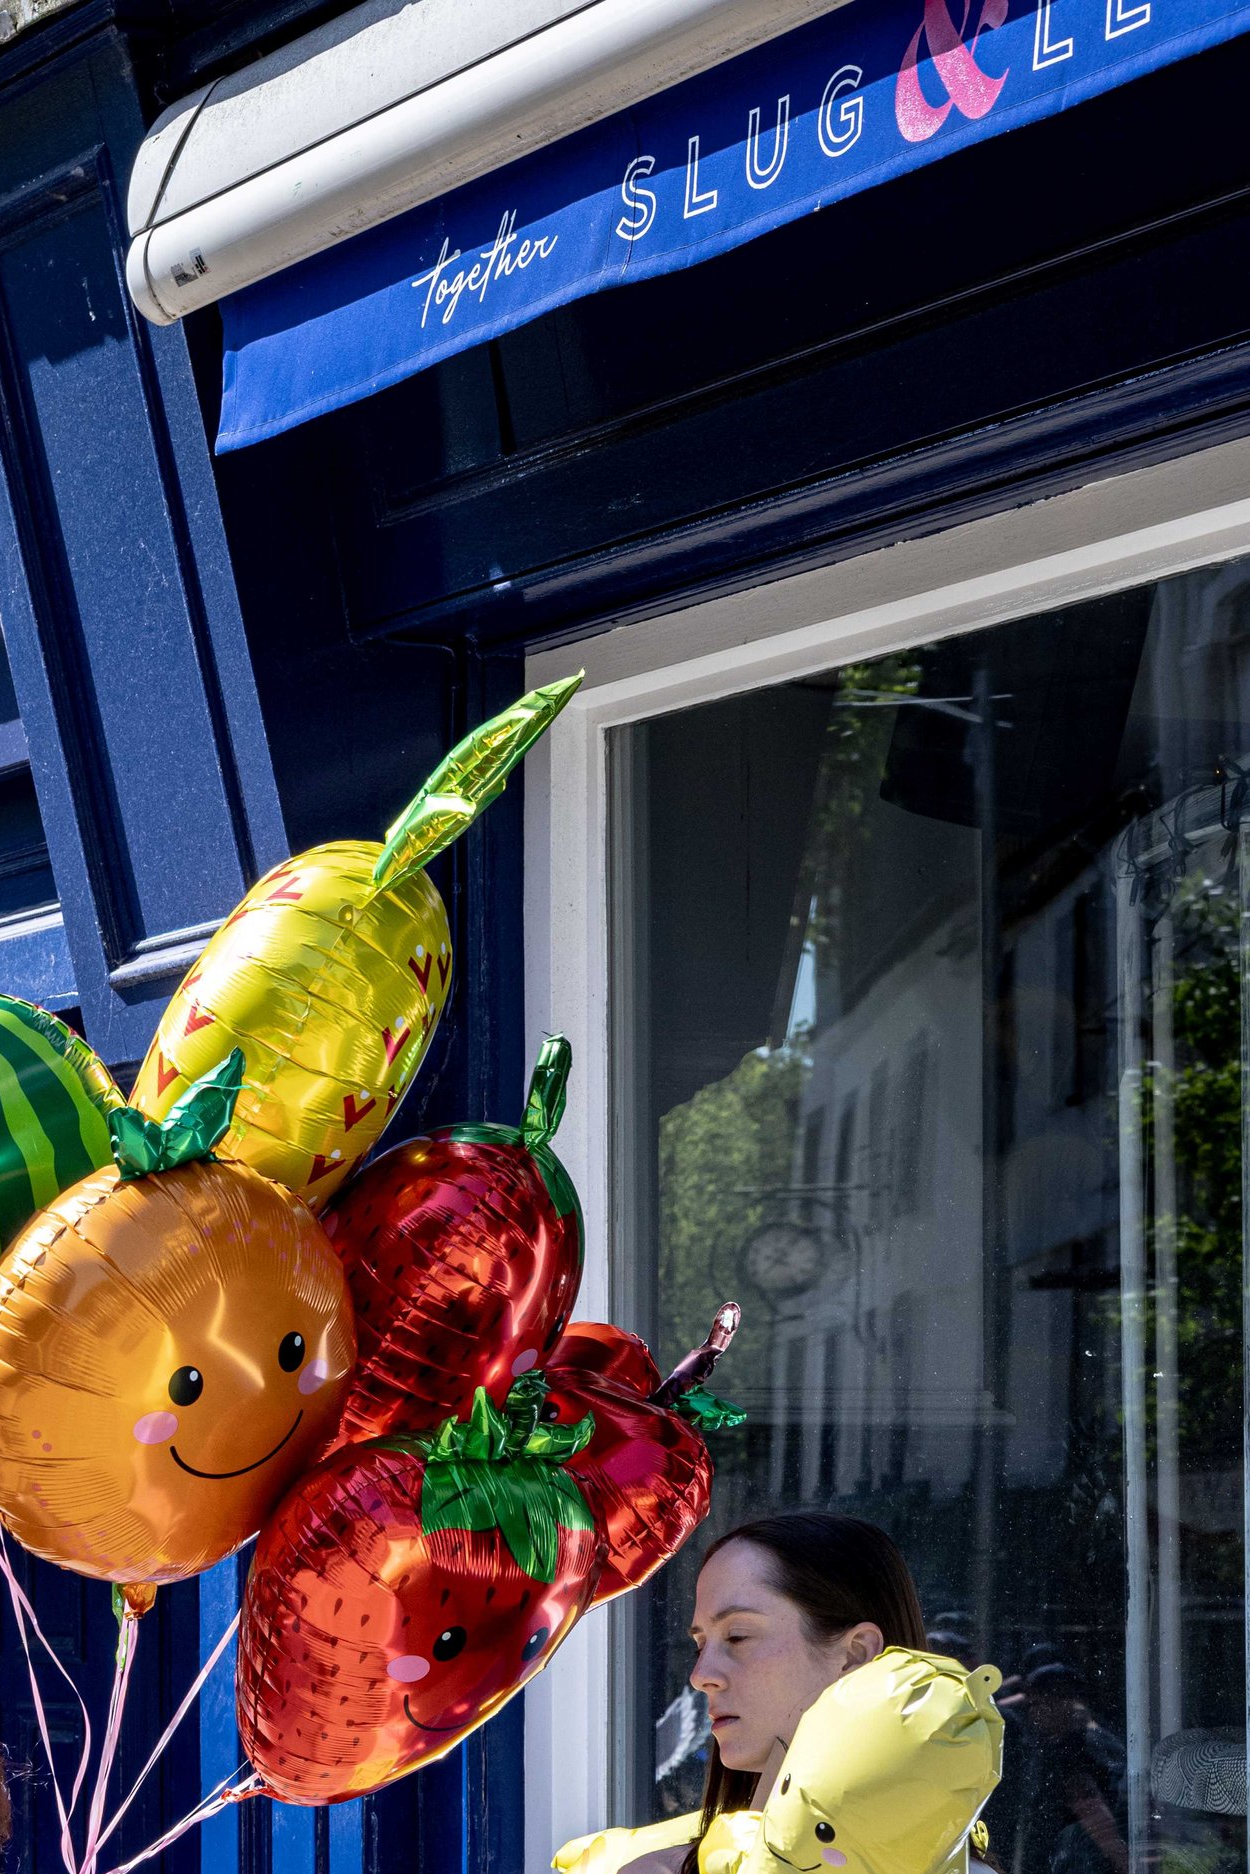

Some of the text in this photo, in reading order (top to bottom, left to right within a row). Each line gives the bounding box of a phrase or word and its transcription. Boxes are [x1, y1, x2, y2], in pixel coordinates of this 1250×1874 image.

[616, 65, 864, 240] SLUG
[895, 0, 1009, 142] &
[411, 209, 558, 328] together
